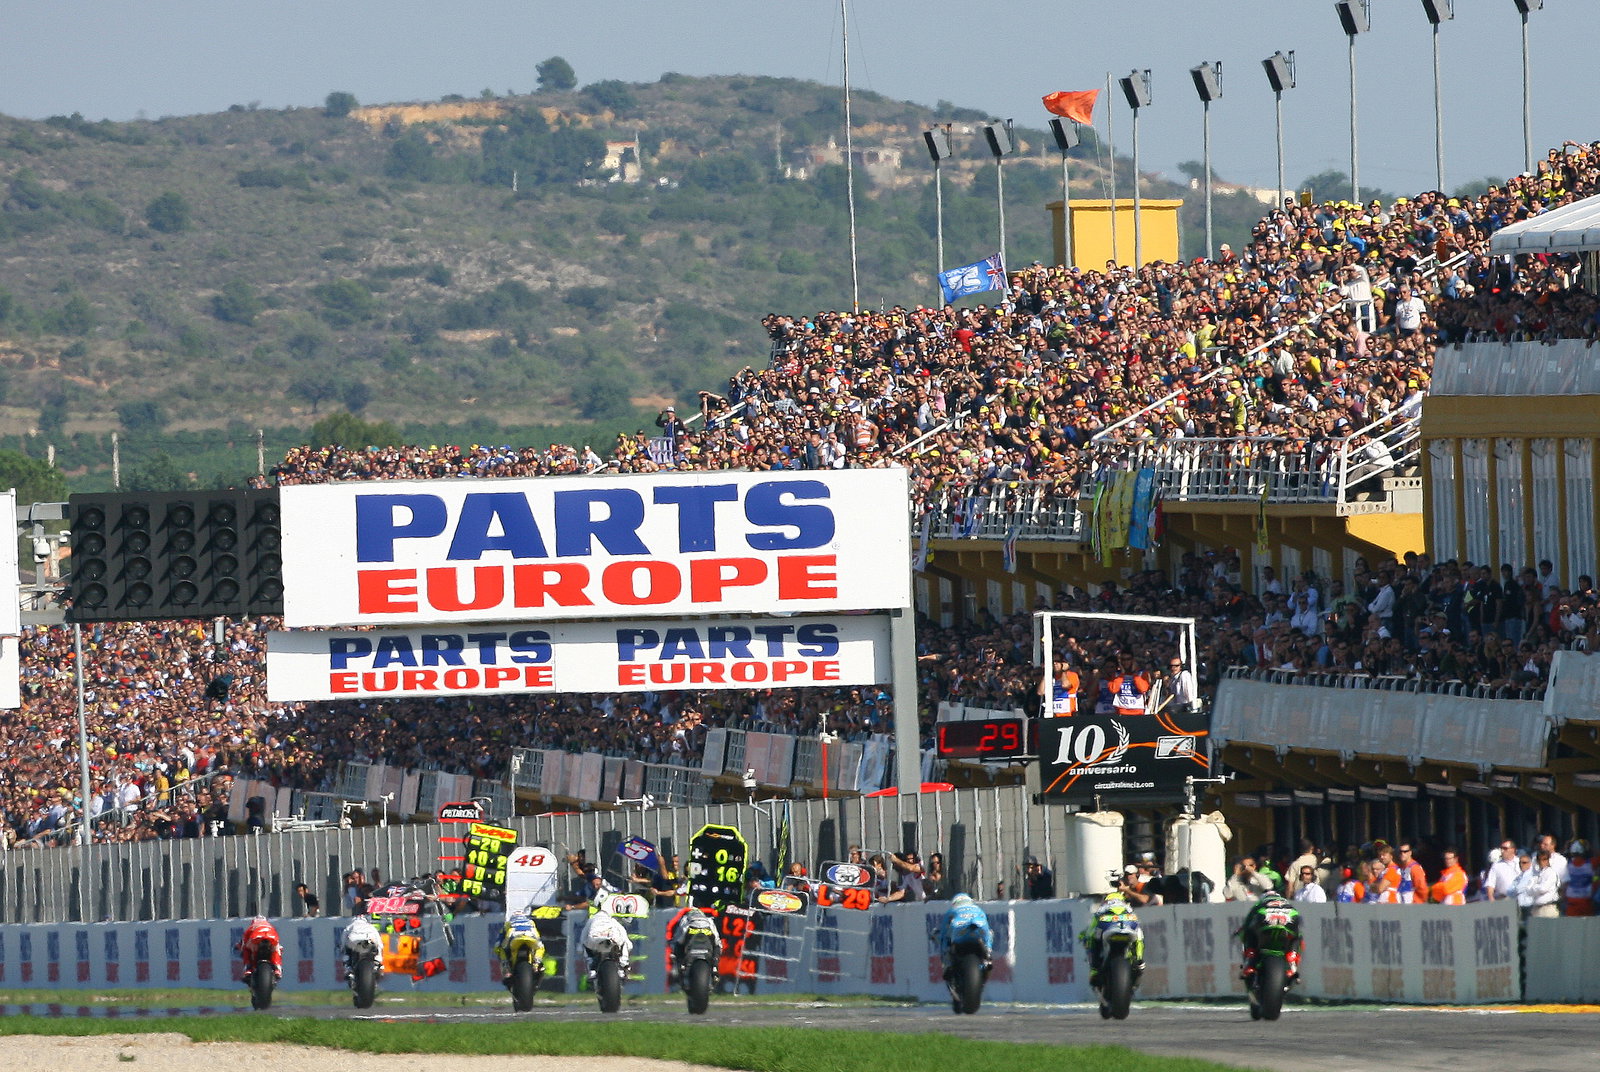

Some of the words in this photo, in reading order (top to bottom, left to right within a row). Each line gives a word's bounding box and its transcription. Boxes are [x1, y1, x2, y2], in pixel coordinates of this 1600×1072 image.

[356, 480, 836, 563] PARTS
[357, 554, 838, 615] EUROPE
[329, 630, 553, 670] PARTS
[616, 624, 840, 661] PARTS
[330, 665, 553, 694] EUROPE
[617, 660, 840, 687] EUROPE
[978, 722, 1020, 751] 29
[1052, 724, 1105, 765] 10
[1069, 764, 1137, 776] aniversario
[442, 808, 480, 819] PEDROSA
[514, 854, 545, 867] 48
[716, 866, 739, 883] 16
[843, 888, 871, 910] 29
